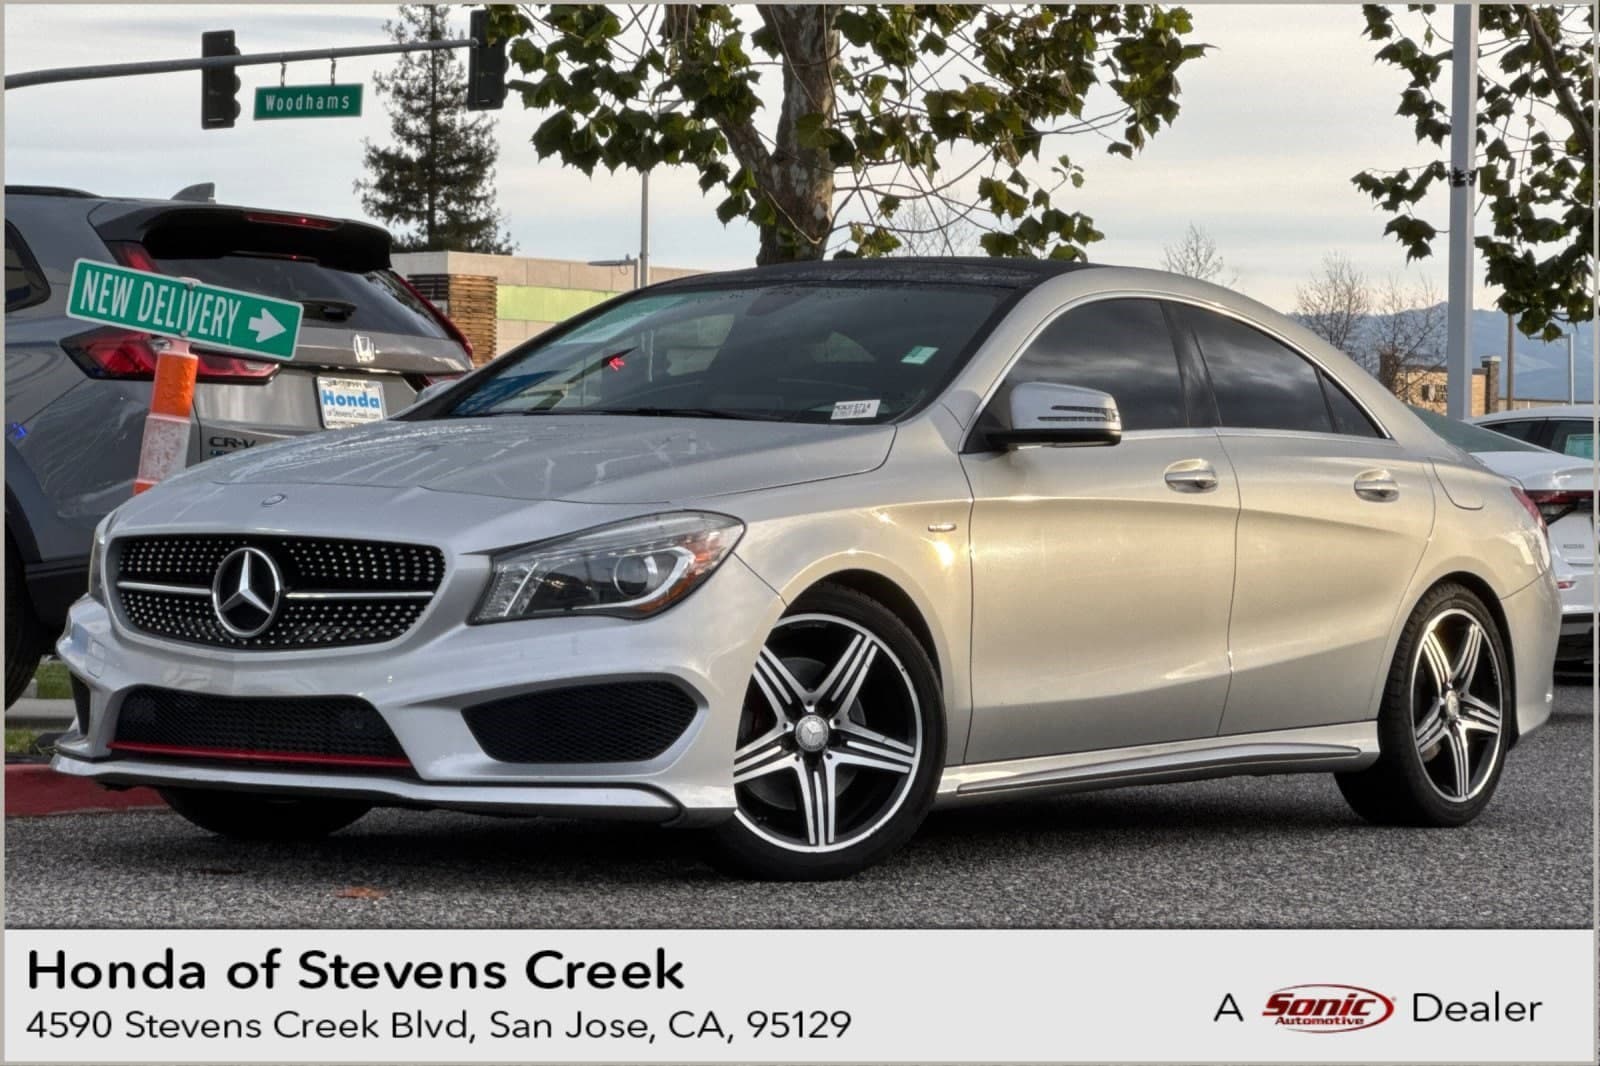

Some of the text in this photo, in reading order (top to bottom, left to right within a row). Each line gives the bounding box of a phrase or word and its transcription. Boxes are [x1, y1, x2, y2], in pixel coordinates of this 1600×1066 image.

[265, 94, 350, 111] Woodhams
[80, 269, 242, 339] NEW DELIVERY
[321, 389, 380, 408] Honda
